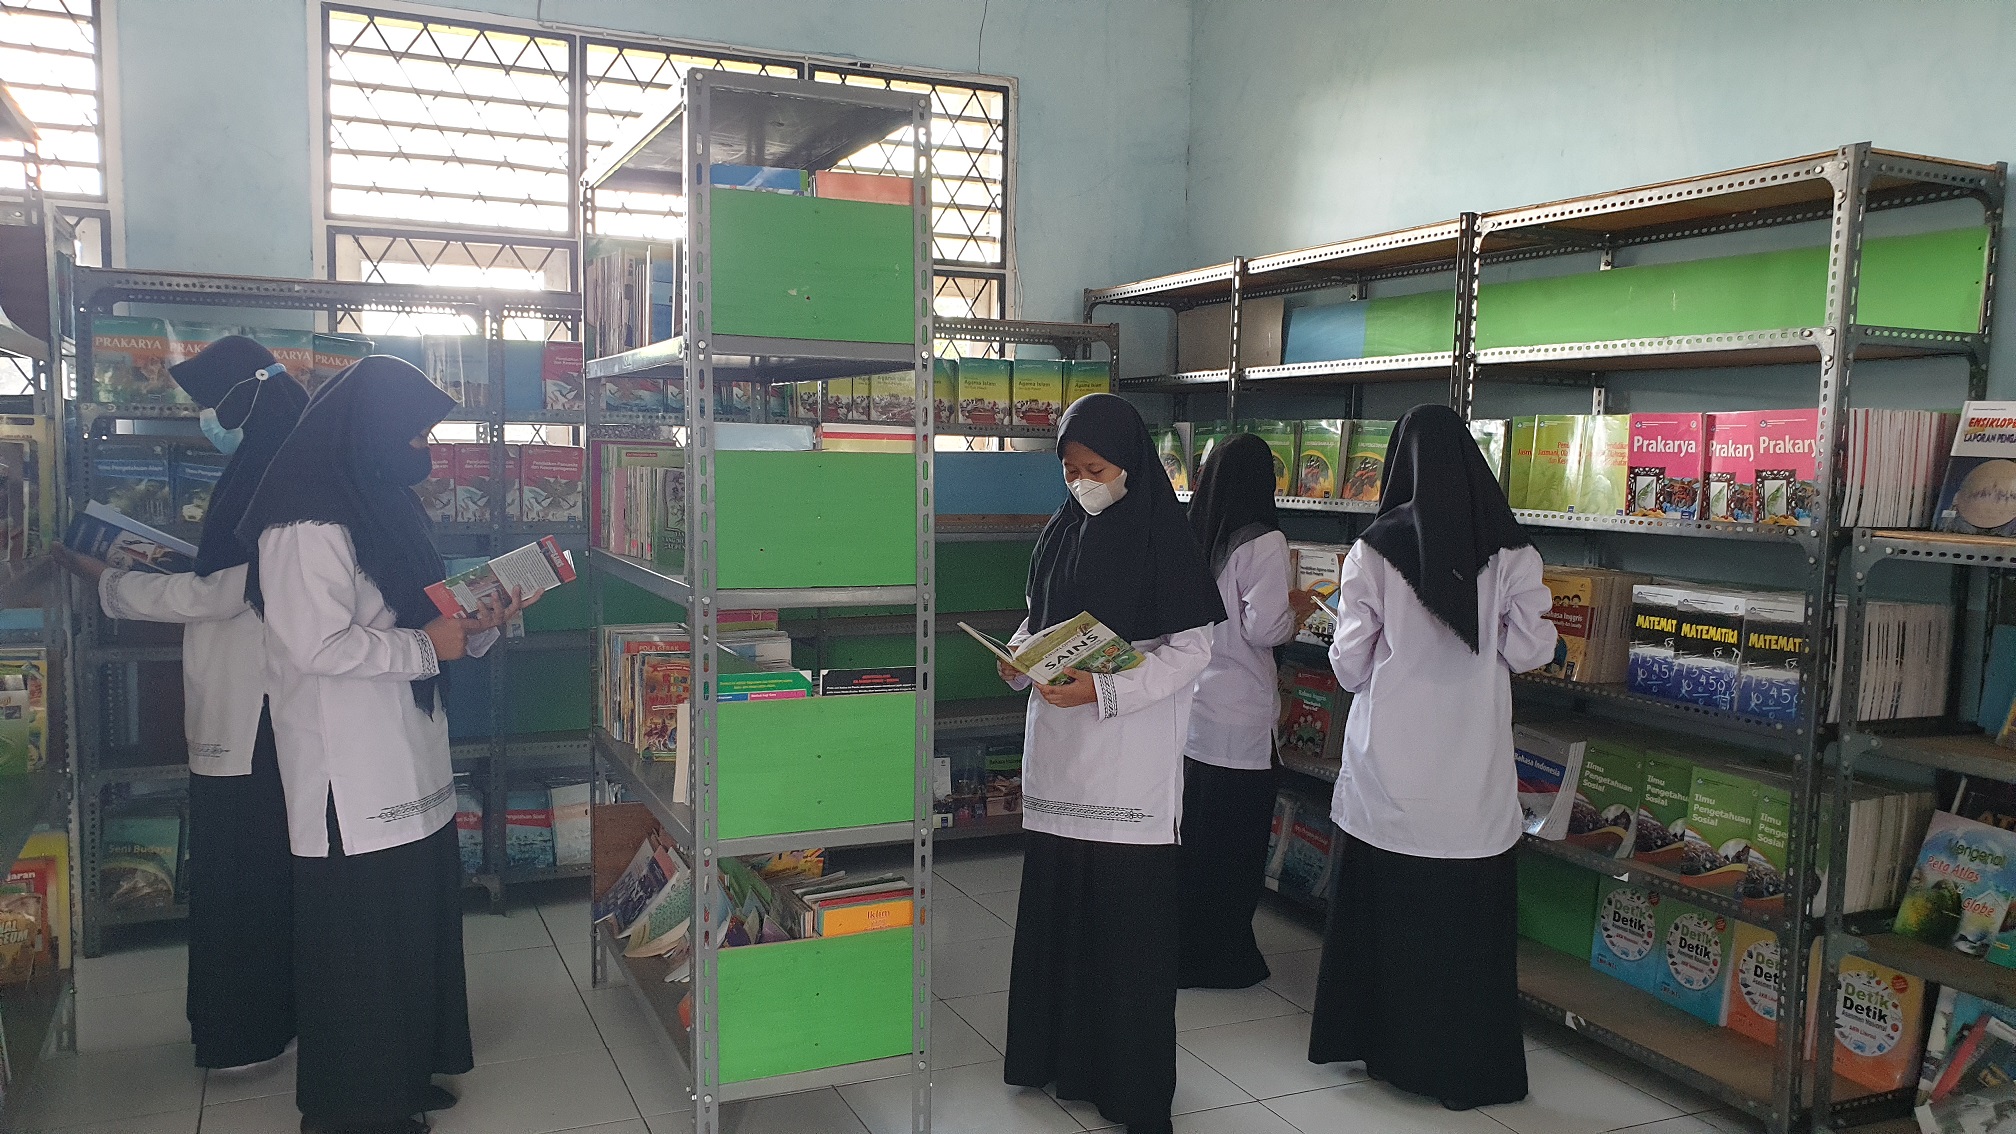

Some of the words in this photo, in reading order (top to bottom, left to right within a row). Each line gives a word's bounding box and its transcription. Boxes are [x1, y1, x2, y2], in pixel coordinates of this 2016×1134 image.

[95, 336, 162, 350] PRAKARYA
[169, 342, 208, 354] PRAK
[271, 349, 312, 361] KARYA
[1969, 417, 2016, 429] ENSIKLOPE
[1633, 436, 1697, 457] Prakarya
[1759, 435, 1817, 458] Prakary
[1964, 433, 1997, 443] LAPORAN
[1997, 433, 2016, 444] PENG
[1518, 448, 1532, 456] Jasm
[1709, 439, 1754, 462] Prakary
[1635, 614, 1677, 634] MATEMAT
[1044, 633, 1099, 671] SAINS
[1748, 632, 1803, 653] MATEMAT
[1514, 752, 1535, 767] Bahasa
[1534, 758, 1561, 778] Indonesia
[1586, 761, 1605, 773] Ilmu
[1582, 779, 1606, 793] Sosial
[1584, 770, 1633, 793] Pengetahuan
[1647, 774, 1666, 787] Ilmu
[1645, 793, 1669, 807] Sosial
[1646, 784, 1688, 802] Pengetahu
[1694, 793, 1716, 806] Ilmu
[1691, 813, 1719, 827] Sosial
[1692, 803, 1752, 825] Pengetahuan
[1760, 812, 1783, 826] Ilmu
[1757, 833, 1786, 849] Sosial
[1758, 823, 1788, 839] Penge
[109, 844, 130, 854] Seni
[1926, 855, 1950, 876] Peta
[1950, 863, 1981, 883] Atlas
[867, 910, 891, 920] Iklim
[1614, 899, 1648, 921] Detik
[1961, 897, 1996, 917] Globe
[1612, 910, 1646, 932] Detik
[1681, 923, 1713, 948] Detik
[1678, 936, 1712, 961] Detik
[1755, 951, 1780, 971] Det
[1753, 964, 1780, 985] Det
[1844, 982, 1889, 1010] Detik
[1842, 995, 1888, 1025] Detik
